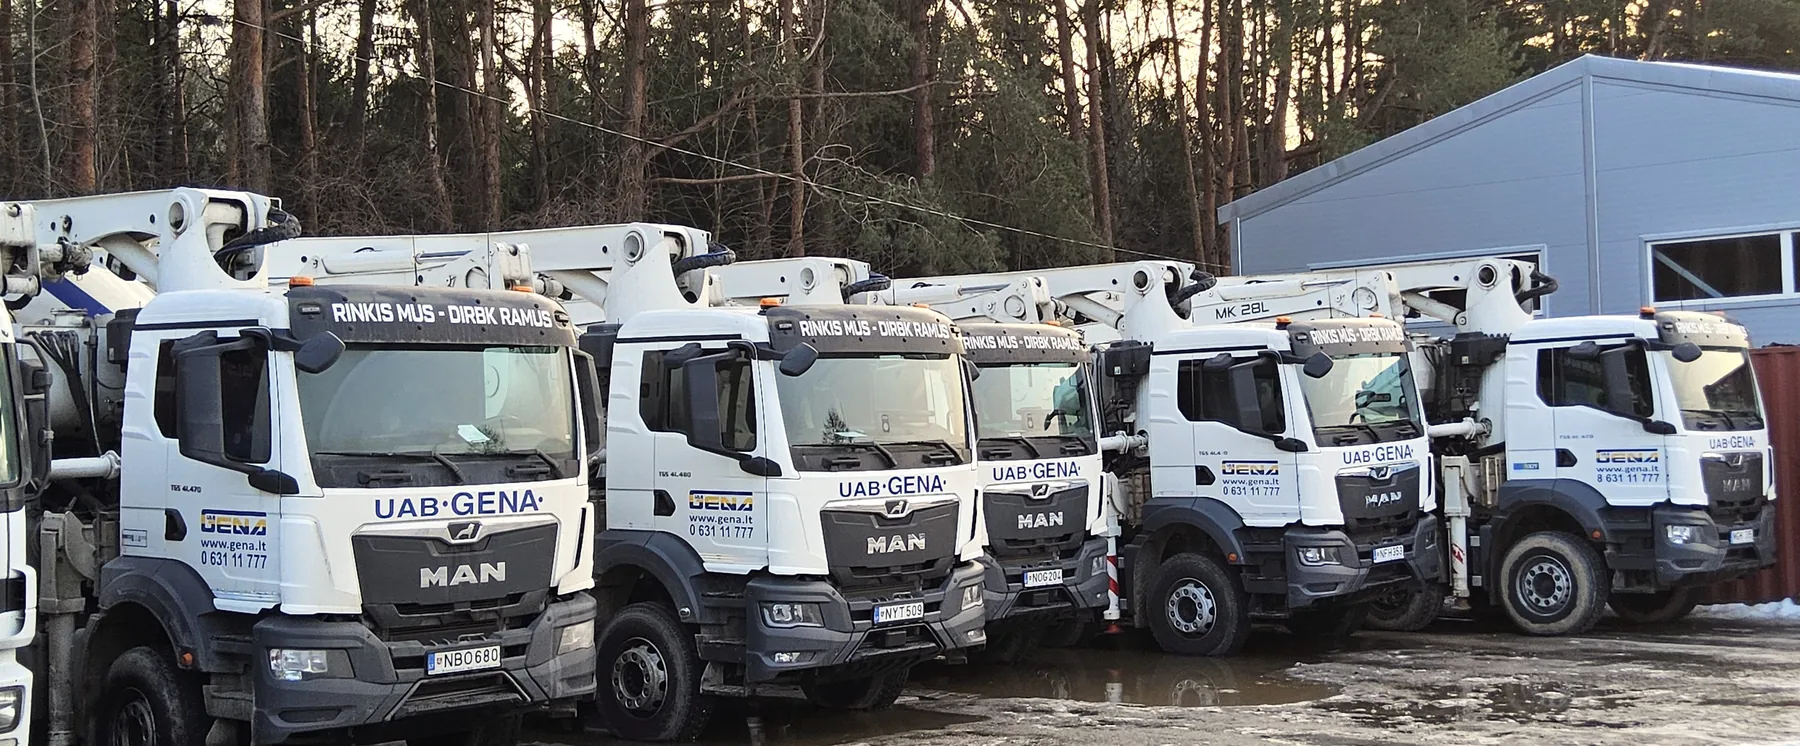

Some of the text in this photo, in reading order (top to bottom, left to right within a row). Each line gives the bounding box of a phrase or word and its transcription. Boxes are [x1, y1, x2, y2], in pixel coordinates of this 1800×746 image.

[332, 303, 394, 322] RINKIS
[396, 304, 435, 322] MUS
[448, 305, 498, 325] DIRBK
[499, 308, 552, 328] RAMUS
[1216, 301, 1270, 320] MK 28L
[800, 320, 842, 336] RINKIS
[843, 320, 871, 336] MUS
[878, 321, 912, 337] DIRBK
[914, 322, 950, 339] RAMUS
[1310, 328, 1339, 345] RINKIS
[1338, 328, 1356, 343] MUS
[962, 336, 996, 349] RINKIS
[997, 336, 1018, 349] MUS
[1024, 336, 1051, 349] DIRBK
[1051, 337, 1080, 350] RAMUS
[1597, 474, 1659, 482] 8 631 11 777
[1723, 479, 1750, 492] MAN
[1223, 486, 1280, 496] 0 631 11 777
[1365, 491, 1402, 508] MAN
[689, 515, 753, 524] www.gena.lt
[1018, 512, 1063, 529] MAN
[690, 524, 753, 538] 0 631 11 777
[201, 540, 267, 552] www.gena.lt
[867, 533, 926, 555] MAN
[201, 551, 267, 569] 0 631 11 777
[420, 561, 506, 588] MAN
[885, 604, 922, 620] NYT509
[444, 648, 498, 668] NBO680
